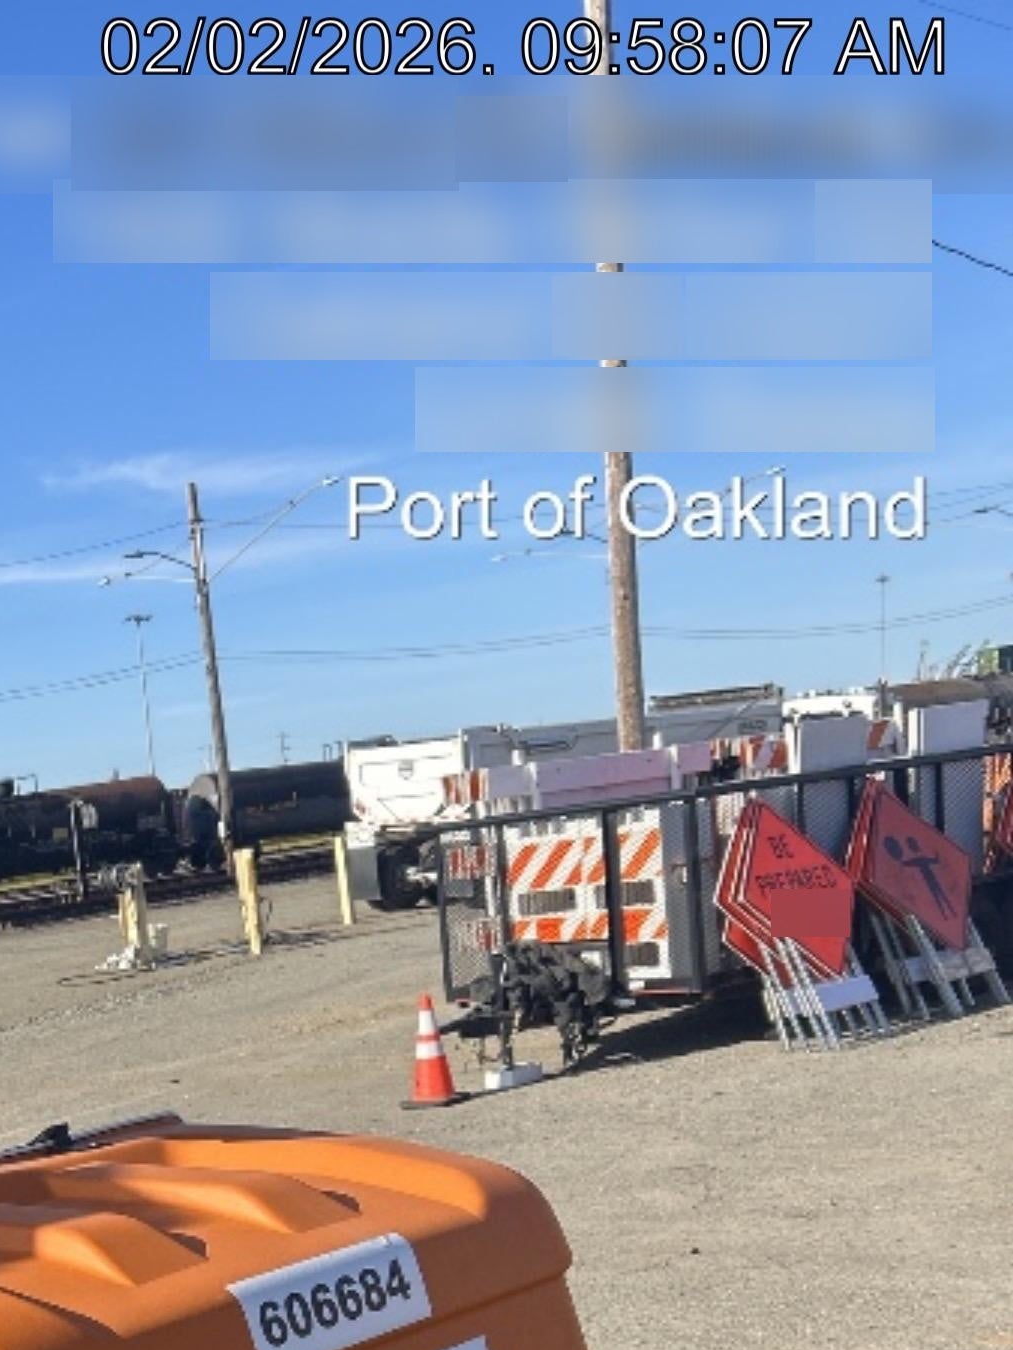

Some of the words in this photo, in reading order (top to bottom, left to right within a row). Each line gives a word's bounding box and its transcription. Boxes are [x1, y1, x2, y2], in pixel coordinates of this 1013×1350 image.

[766, 834, 794, 859] BE
[755, 864, 838, 898] PREPARED
[259, 1259, 411, 1347] 606684
